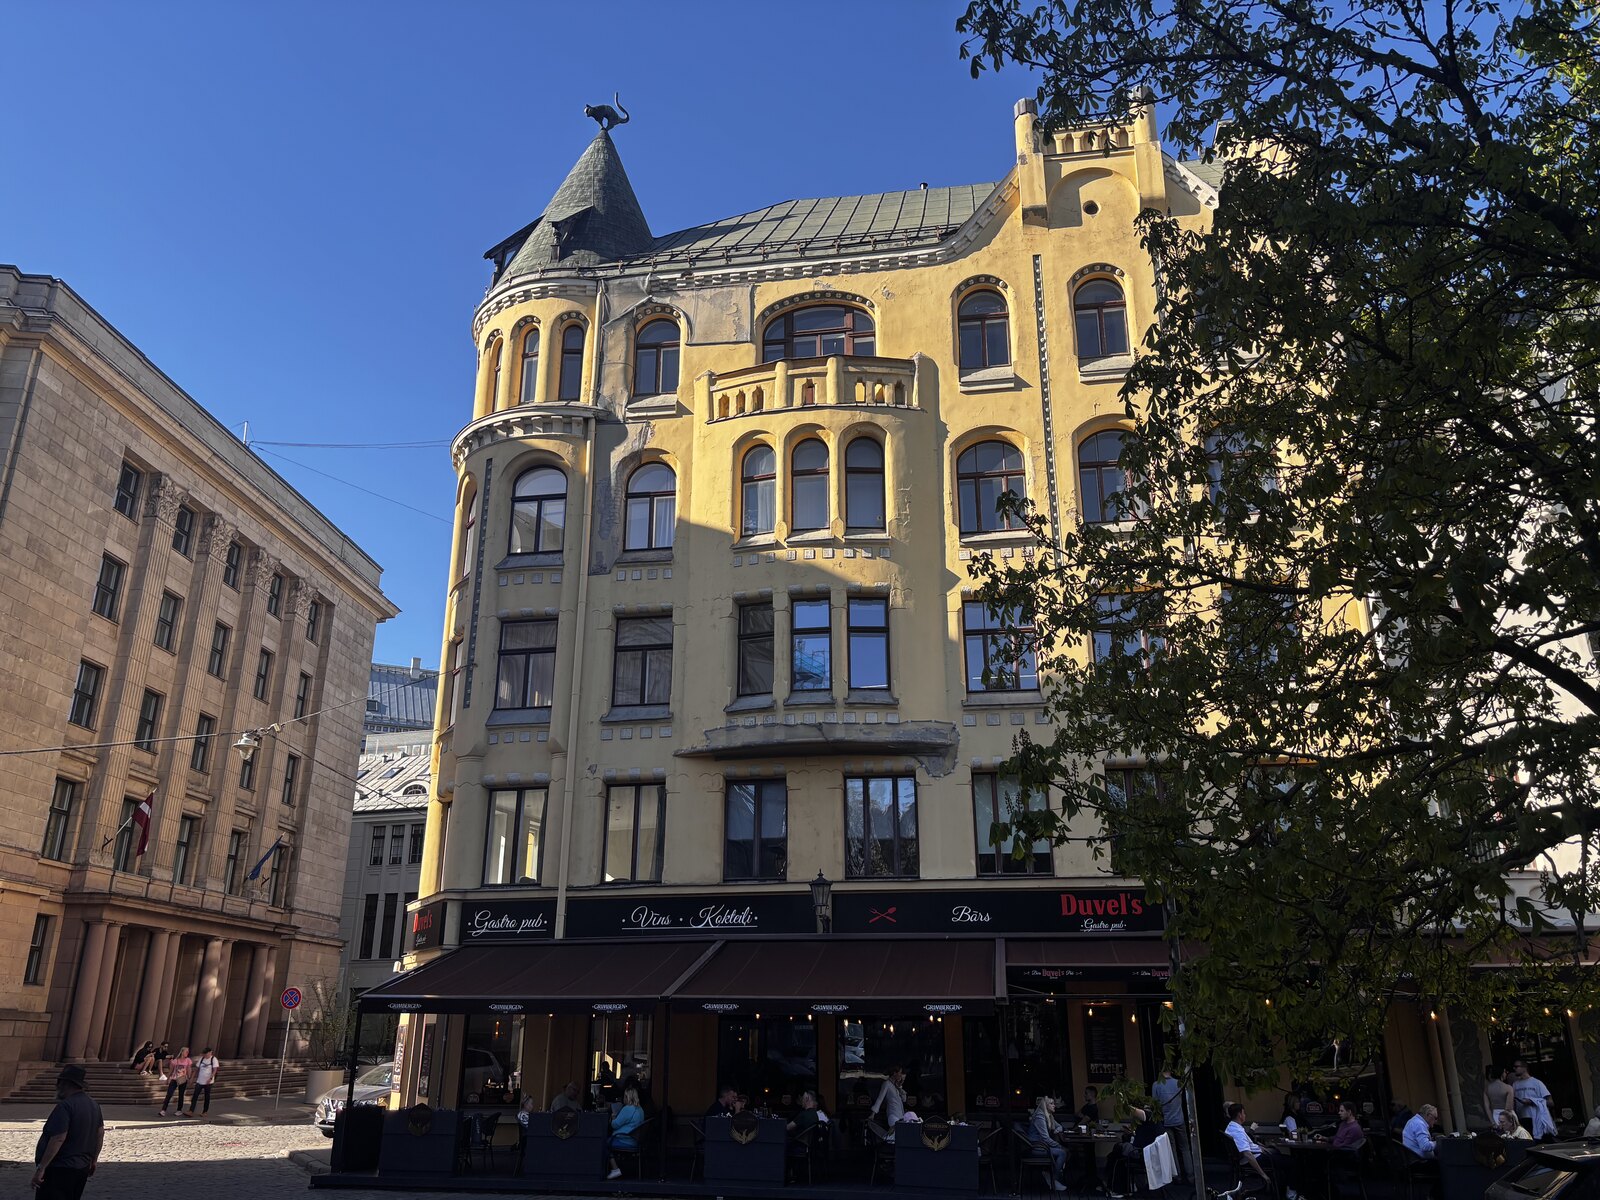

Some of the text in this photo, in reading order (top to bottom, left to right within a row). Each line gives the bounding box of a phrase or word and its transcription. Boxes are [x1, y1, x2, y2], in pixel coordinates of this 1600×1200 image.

[951, 905, 992, 923] Bārs
[1060, 892, 1143, 916] Duvel's
[472, 909, 543, 937] Gastro pub
[1082, 918, 1125, 932] Gastro pub
